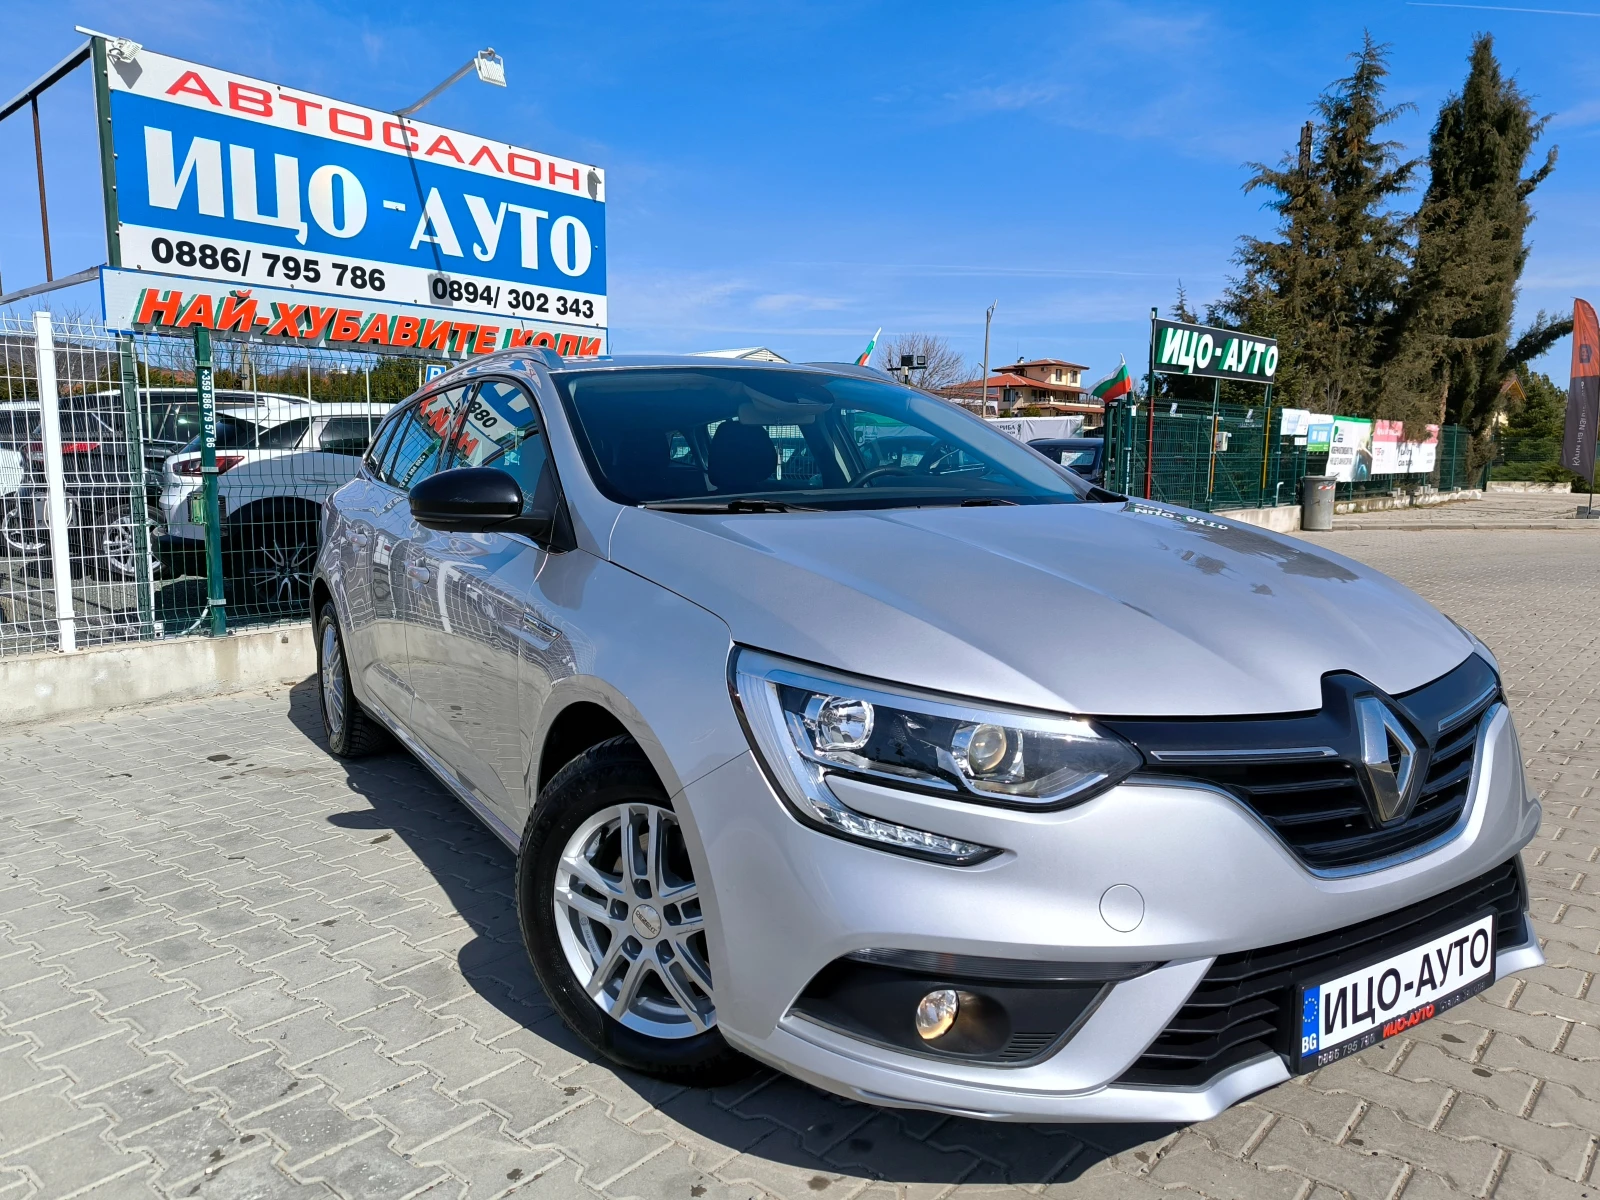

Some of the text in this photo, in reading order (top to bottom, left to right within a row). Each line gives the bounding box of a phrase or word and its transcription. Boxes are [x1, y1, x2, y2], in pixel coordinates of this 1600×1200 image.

[165, 70, 581, 191] АВТОСАЛОН
[151, 237, 386, 292] 0886/ 795 786
[432, 277, 595, 319] 0894/ 302 343
[1159, 327, 1279, 377] ИЦО-АУТО
[202, 369, 216, 448] +359 886 79 57 86
[1324, 928, 1489, 1036] ИЦО-АУТО
[1301, 1033, 1318, 1054] BG
[1382, 1003, 1436, 1039] ИЦО-АУТО
[1342, 1041, 1358, 1056] 795
